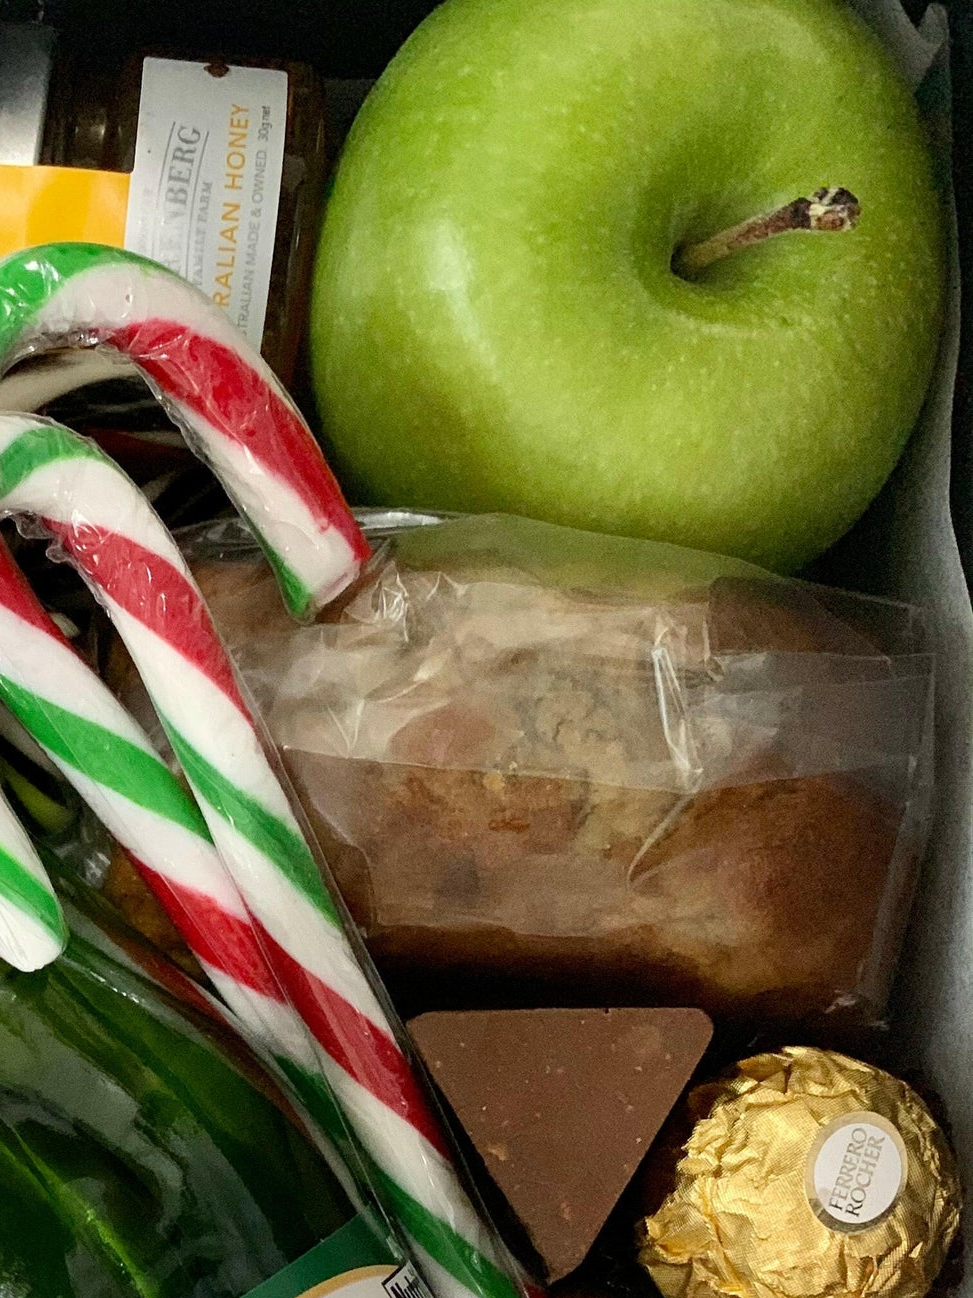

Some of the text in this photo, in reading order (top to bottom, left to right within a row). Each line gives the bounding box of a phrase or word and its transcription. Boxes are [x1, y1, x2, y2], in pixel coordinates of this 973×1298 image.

[224, 103, 249, 190] HONEY
[251, 150, 267, 204] OWNED
[830, 1127, 868, 1211] FERRERO
[844, 1135, 886, 1217] ROCHER
